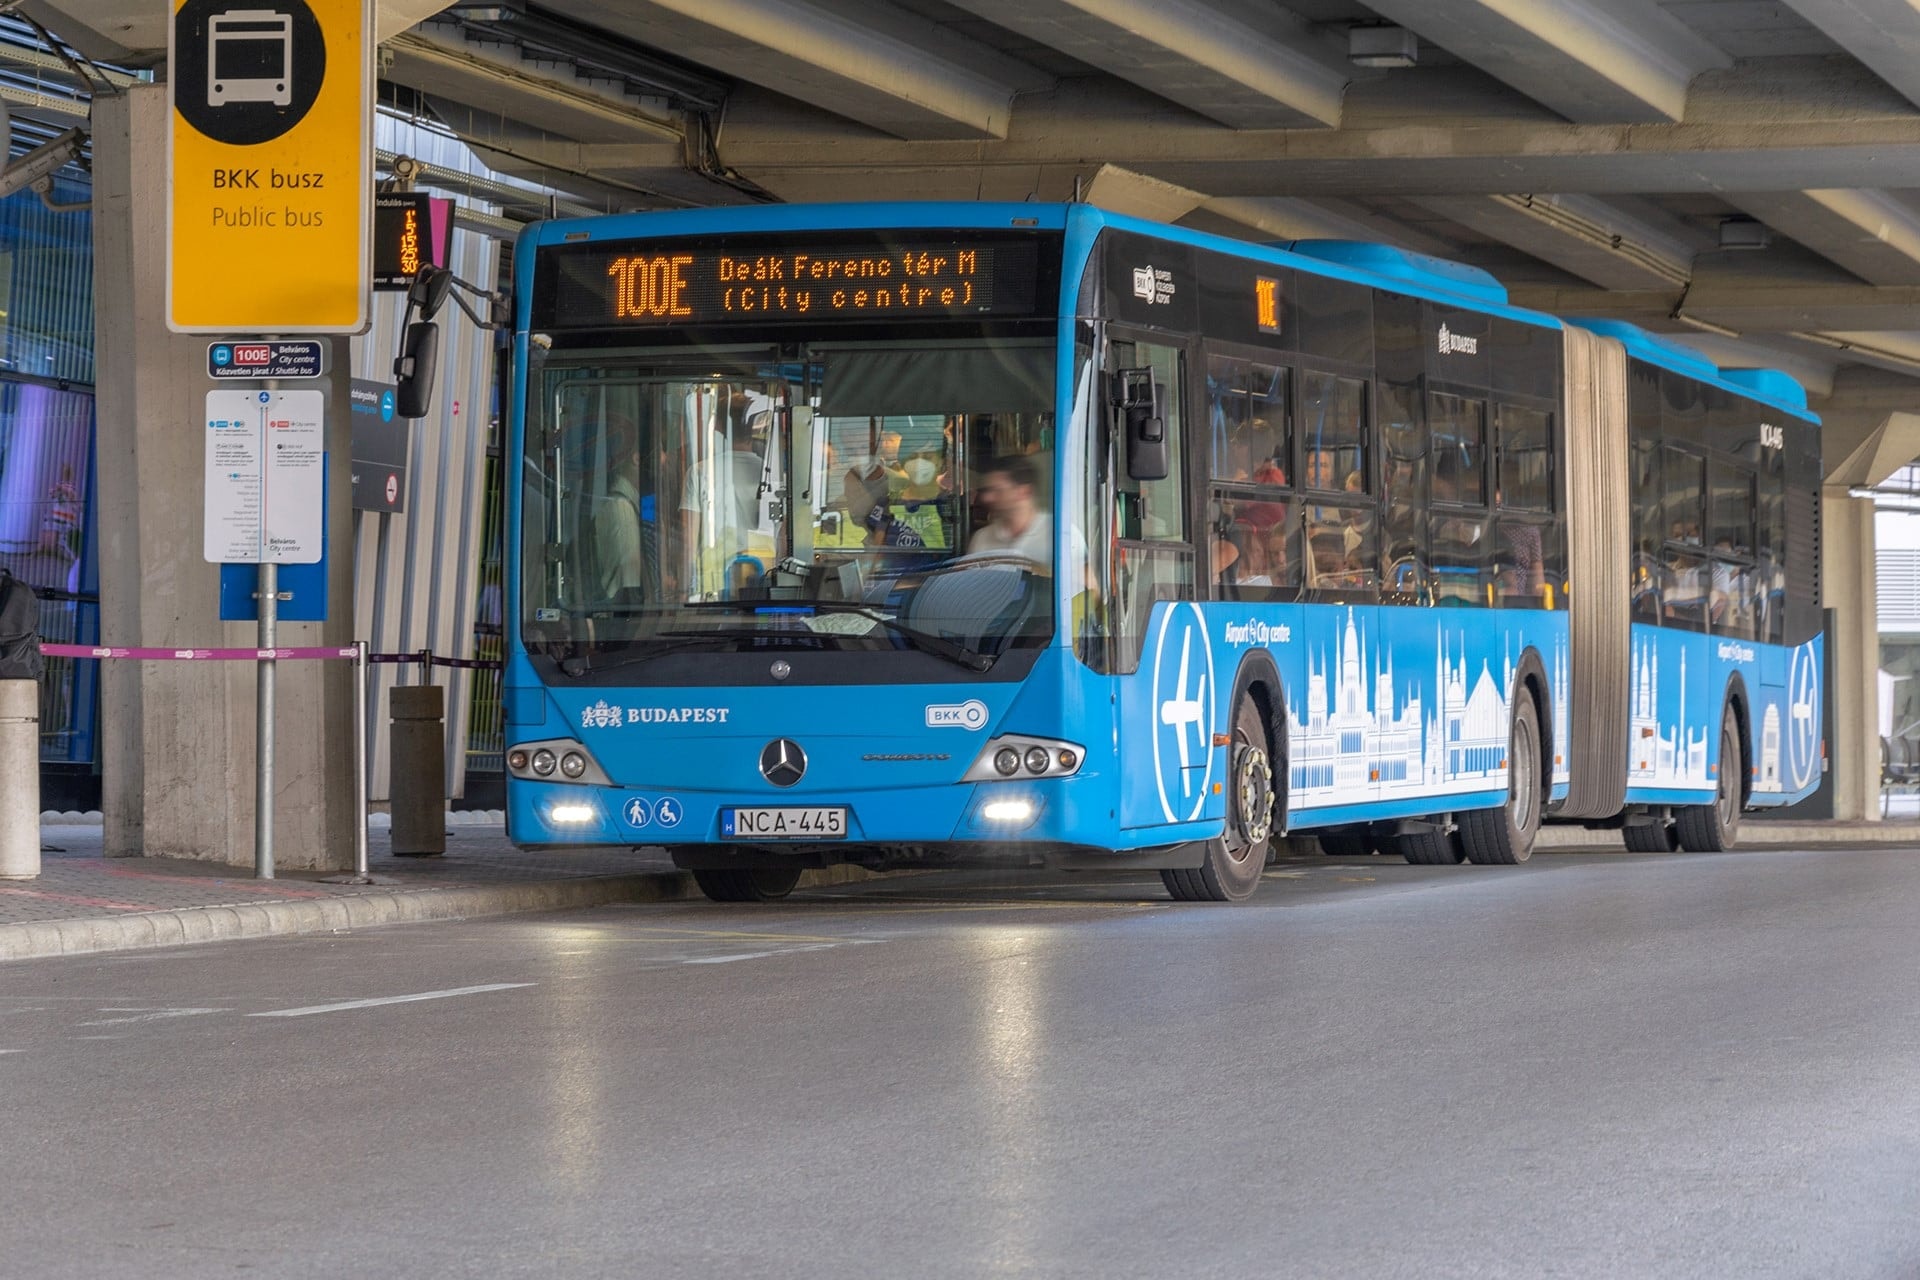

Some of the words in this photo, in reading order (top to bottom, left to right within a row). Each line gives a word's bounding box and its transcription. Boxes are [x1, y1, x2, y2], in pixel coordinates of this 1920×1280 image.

[213, 169, 259, 188] BKK
[271, 168, 324, 188] busz
[212, 206, 276, 227] Public
[285, 206, 323, 227] bus
[720, 257, 783, 280] Deák
[795, 255, 891, 278] Ferenc
[904, 252, 947, 276] tér
[958, 250, 975, 274] M
[608, 256, 692, 317] 100E
[724, 287, 810, 312] (City
[832, 281, 971, 308] centre)
[237, 349, 268, 361] 100E
[279, 345, 310, 354] Belváros
[1450, 334, 1477, 355] BUDAPEST
[279, 355, 292, 365] City
[293, 356, 315, 364] centre
[216, 367, 251, 375] Közvetlen
[252, 367, 269, 377] járat
[275, 366, 299, 375] Shuttle
[300, 367, 313, 375] bus
[269, 545, 281, 553] City
[1225, 621, 1249, 648] Airport
[1257, 621, 1270, 648] City
[1270, 623, 1291, 642] centre
[628, 708, 729, 723] BUDAPEST
[935, 711, 961, 720] BKK
[725, 824, 733, 832] H
[739, 811, 840, 832] NCA-445
